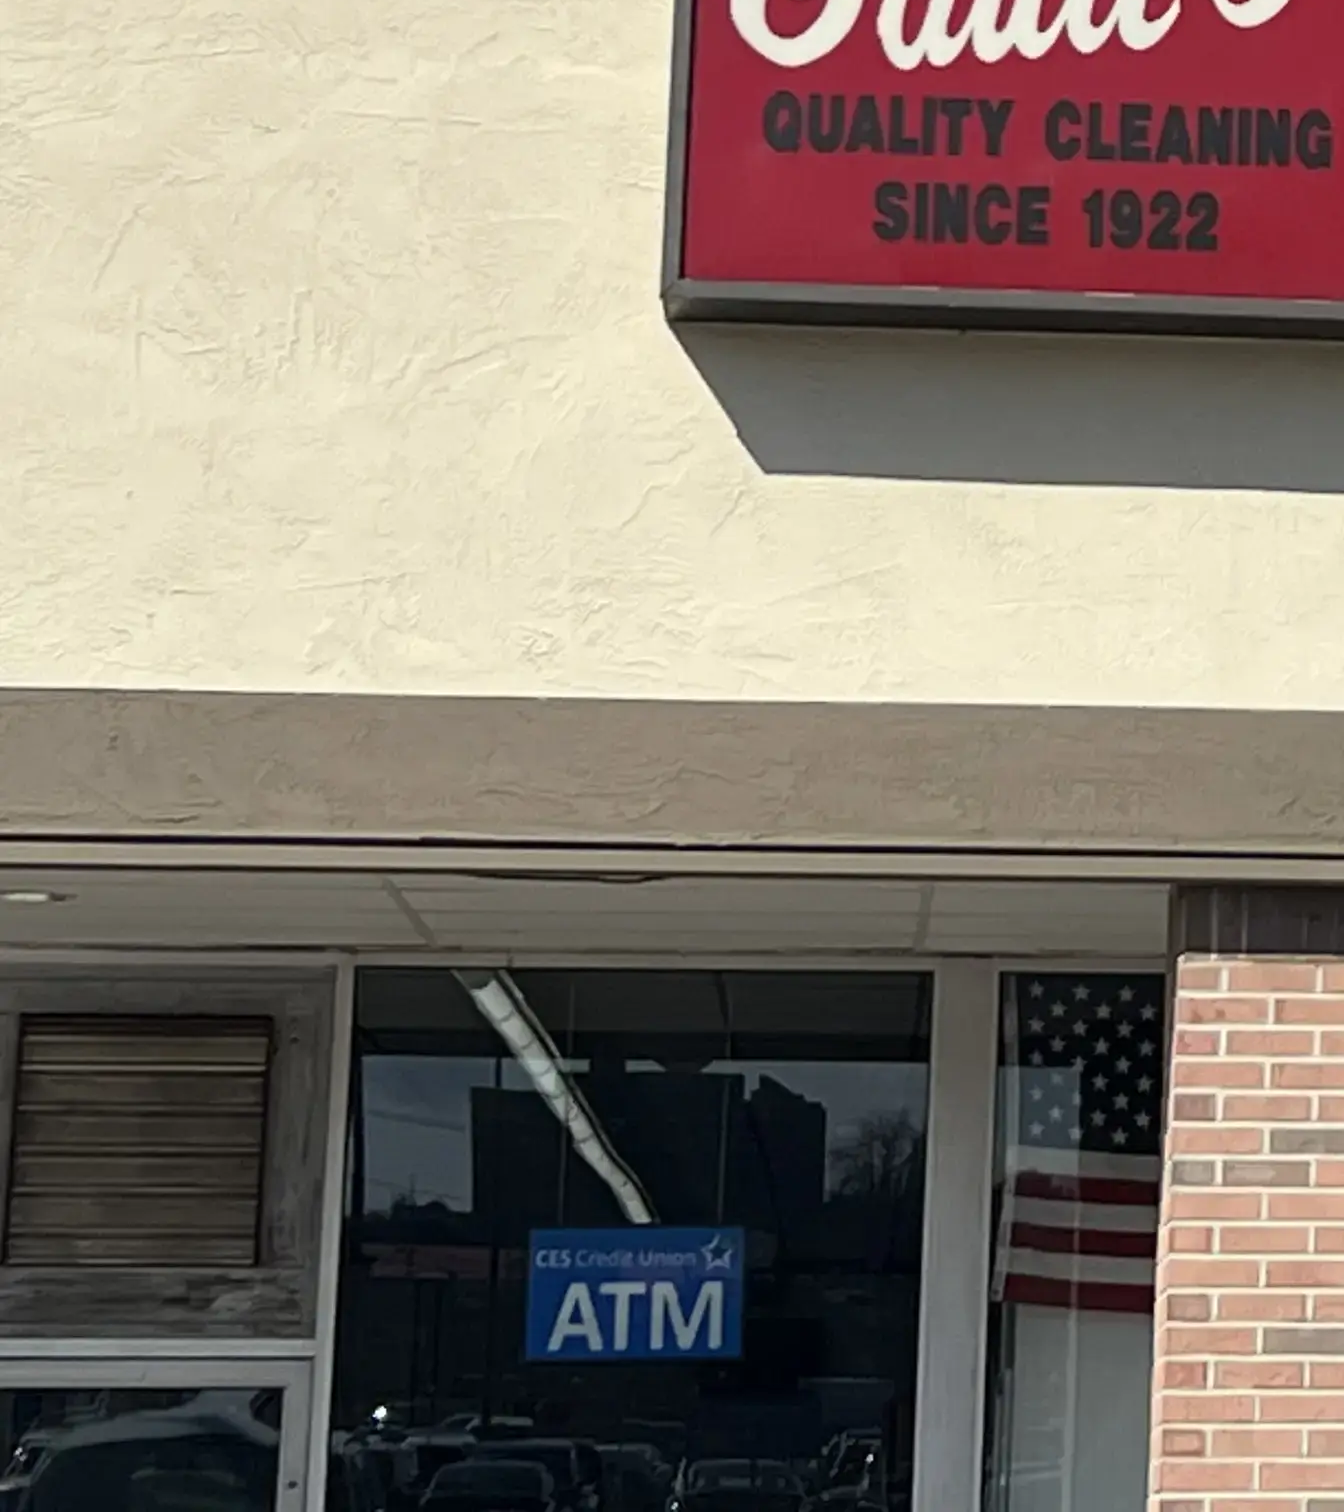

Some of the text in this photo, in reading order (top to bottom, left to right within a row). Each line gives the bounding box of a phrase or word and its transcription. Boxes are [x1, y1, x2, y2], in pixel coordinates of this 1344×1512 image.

[762, 90, 1333, 169] QUALITY CLEANING
[872, 181, 1220, 251] SINCE 1922
[535, 1249, 571, 1268] CES
[547, 1280, 723, 1352] ATM
